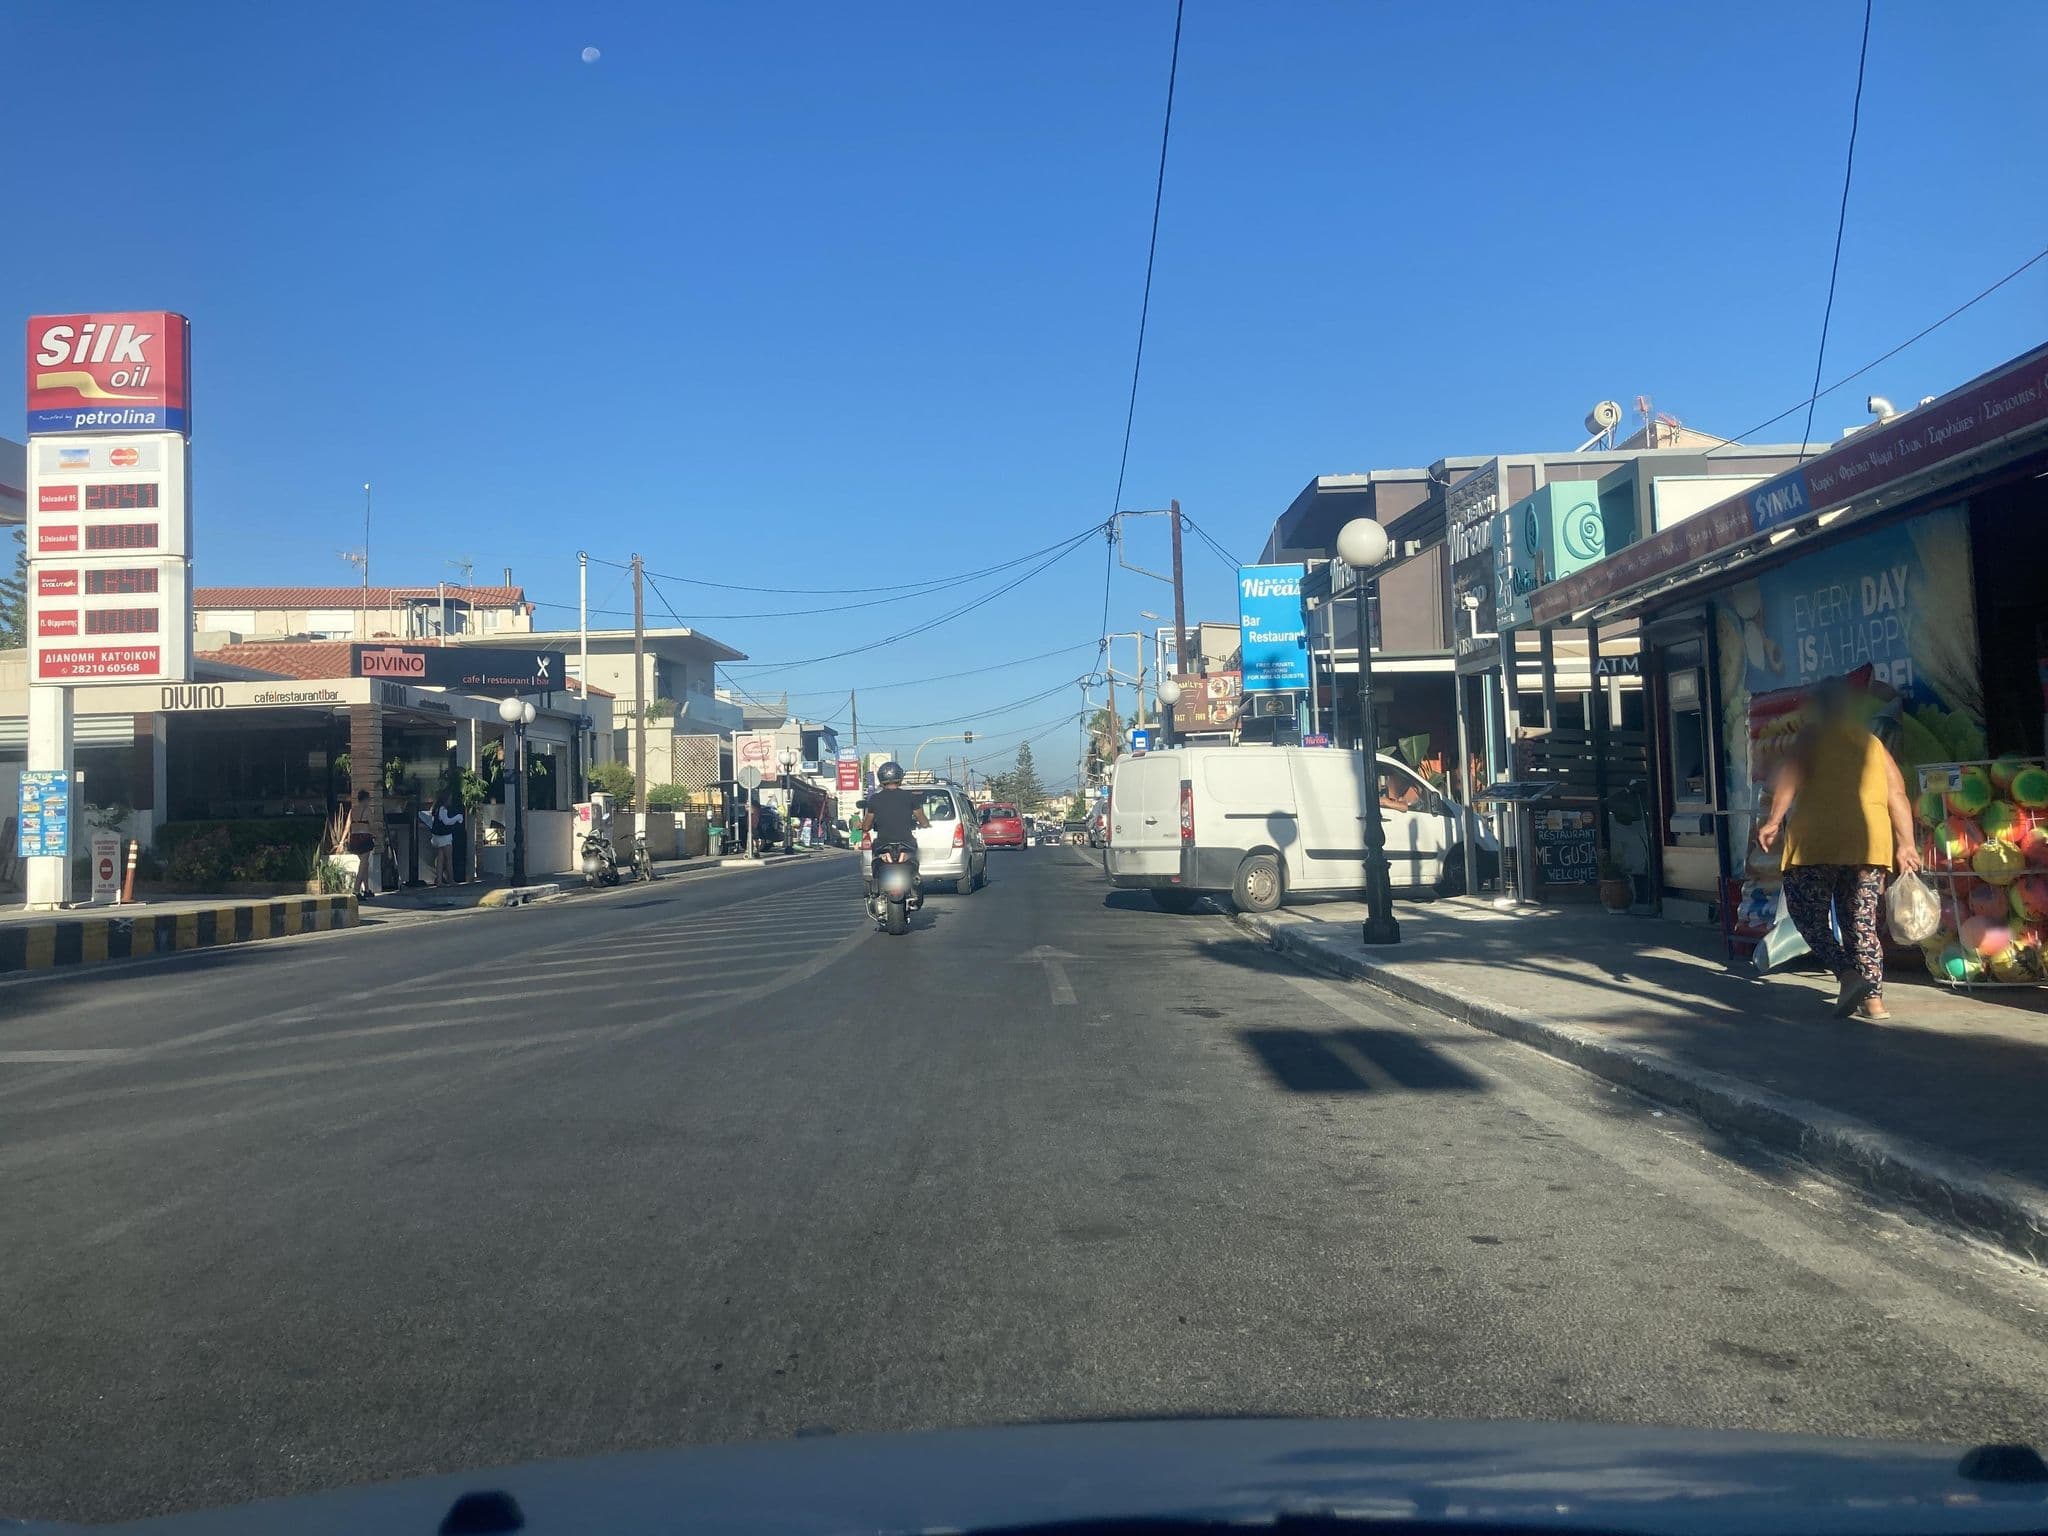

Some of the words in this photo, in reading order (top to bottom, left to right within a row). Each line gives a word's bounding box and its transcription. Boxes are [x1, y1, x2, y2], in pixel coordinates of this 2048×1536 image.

[36, 323, 152, 366] Silk
[110, 366, 151, 388] oil
[75, 410, 155, 428] petrolina
[42, 495, 68, 503] Unleaded
[1755, 482, 1803, 526] SYNKA
[1794, 583, 1852, 632] EVERY
[1861, 564, 1908, 616] DAY
[1242, 615, 1260, 627] Bar
[1798, 634, 1818, 674] IS
[1822, 631, 1834, 672] A
[1840, 608, 1913, 665] HAPPY
[45, 653, 95, 664] ΔΙΑΝΟΜΗ
[363, 656, 424, 672] DIVINO
[1595, 657, 1639, 675] ATM
[72, 665, 105, 674] 28210
[107, 663, 139, 672] 60568
[463, 675, 481, 684] cafe
[487, 677, 529, 686] restaurant
[536, 678, 549, 686] bar
[161, 686, 224, 710] DIVINO
[1538, 829, 1597, 841] RESTAURANT
[1535, 846, 1553, 865] ME
[1560, 841, 1599, 866] GUSTA
[1547, 867, 1597, 880] WELCOME
